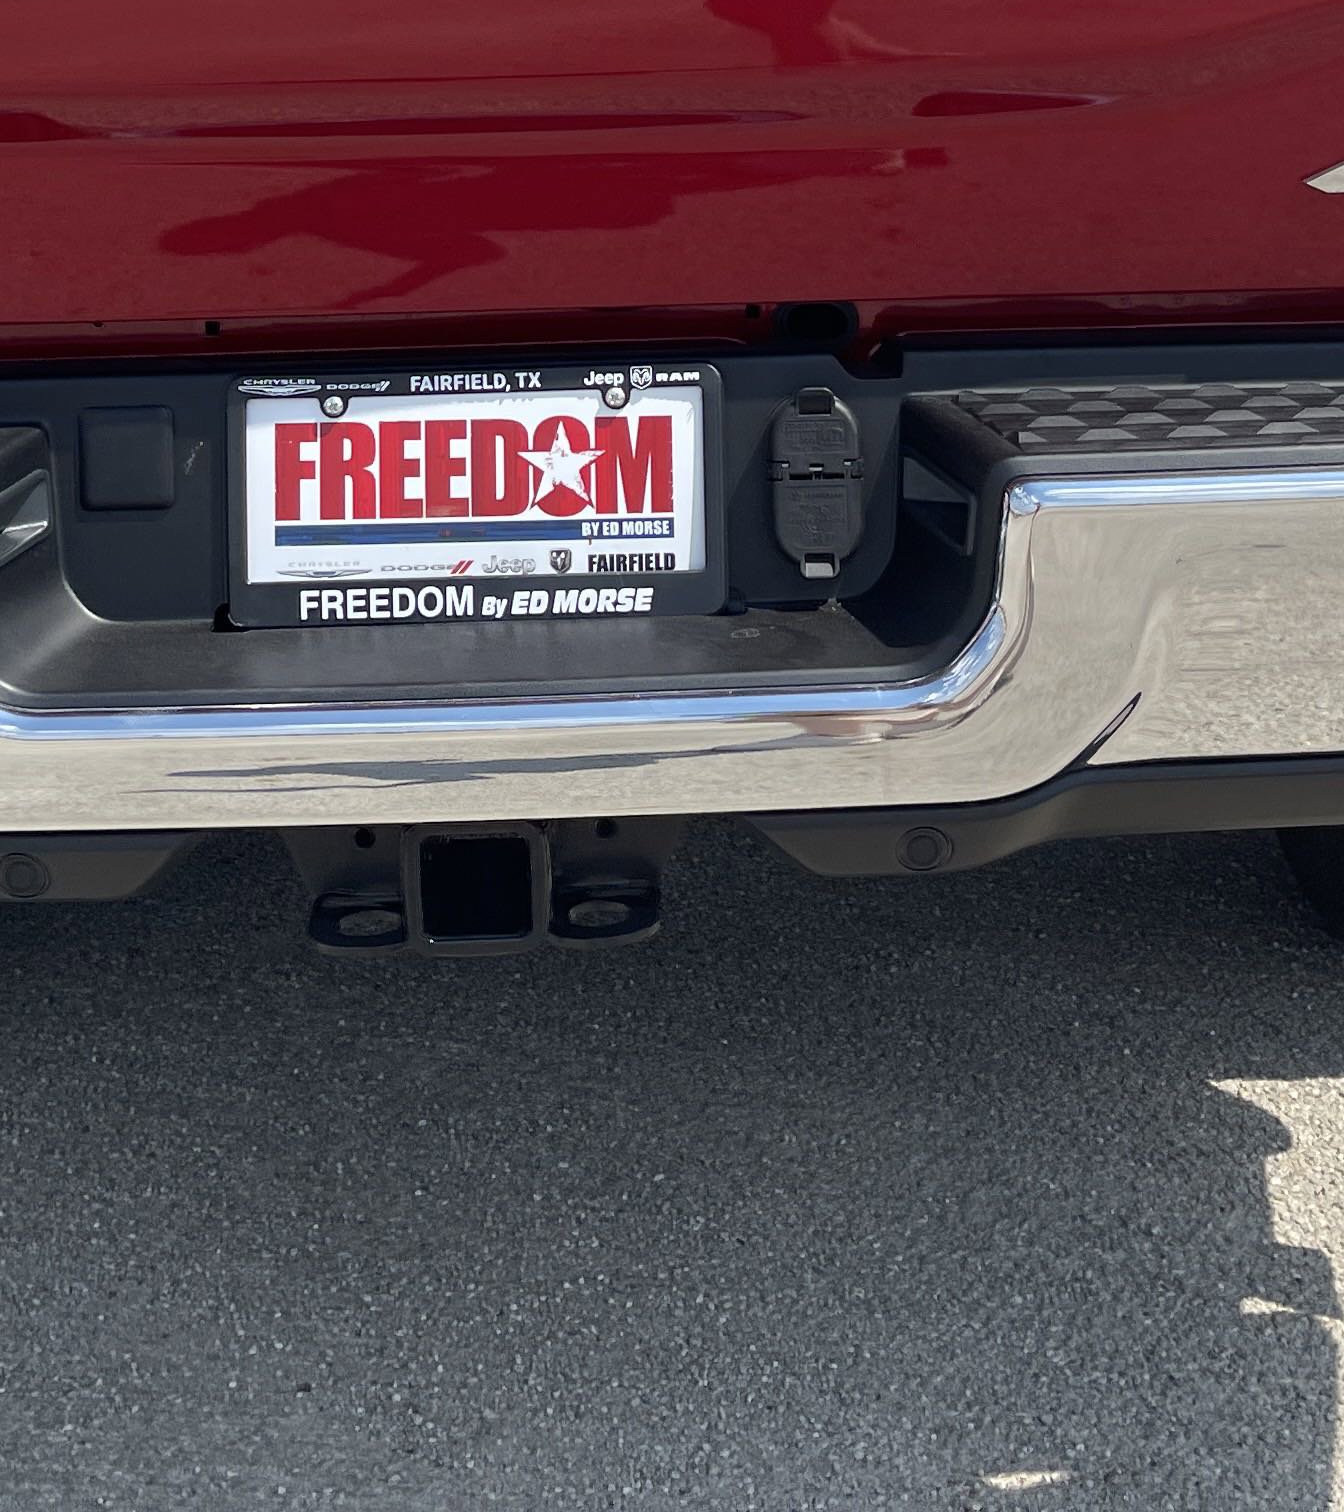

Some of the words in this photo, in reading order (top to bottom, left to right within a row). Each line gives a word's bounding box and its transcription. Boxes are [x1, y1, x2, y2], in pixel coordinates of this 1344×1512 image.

[243, 378, 316, 386] CHRYSLER
[410, 373, 510, 391] FAIRFIELD,
[515, 372, 541, 388] TX
[584, 371, 624, 386] Jeep
[656, 372, 700, 382] RAM
[275, 415, 674, 521] FREEDOM
[582, 521, 599, 537] BY
[603, 521, 620, 536] ED
[622, 520, 670, 535] MORSE
[482, 555, 536, 574] Jeep
[588, 553, 676, 572] FAIRFIELD
[299, 585, 474, 621] FREEDOM
[481, 596, 507, 619] By
[511, 590, 548, 616] ED
[552, 587, 654, 615] MORSE
